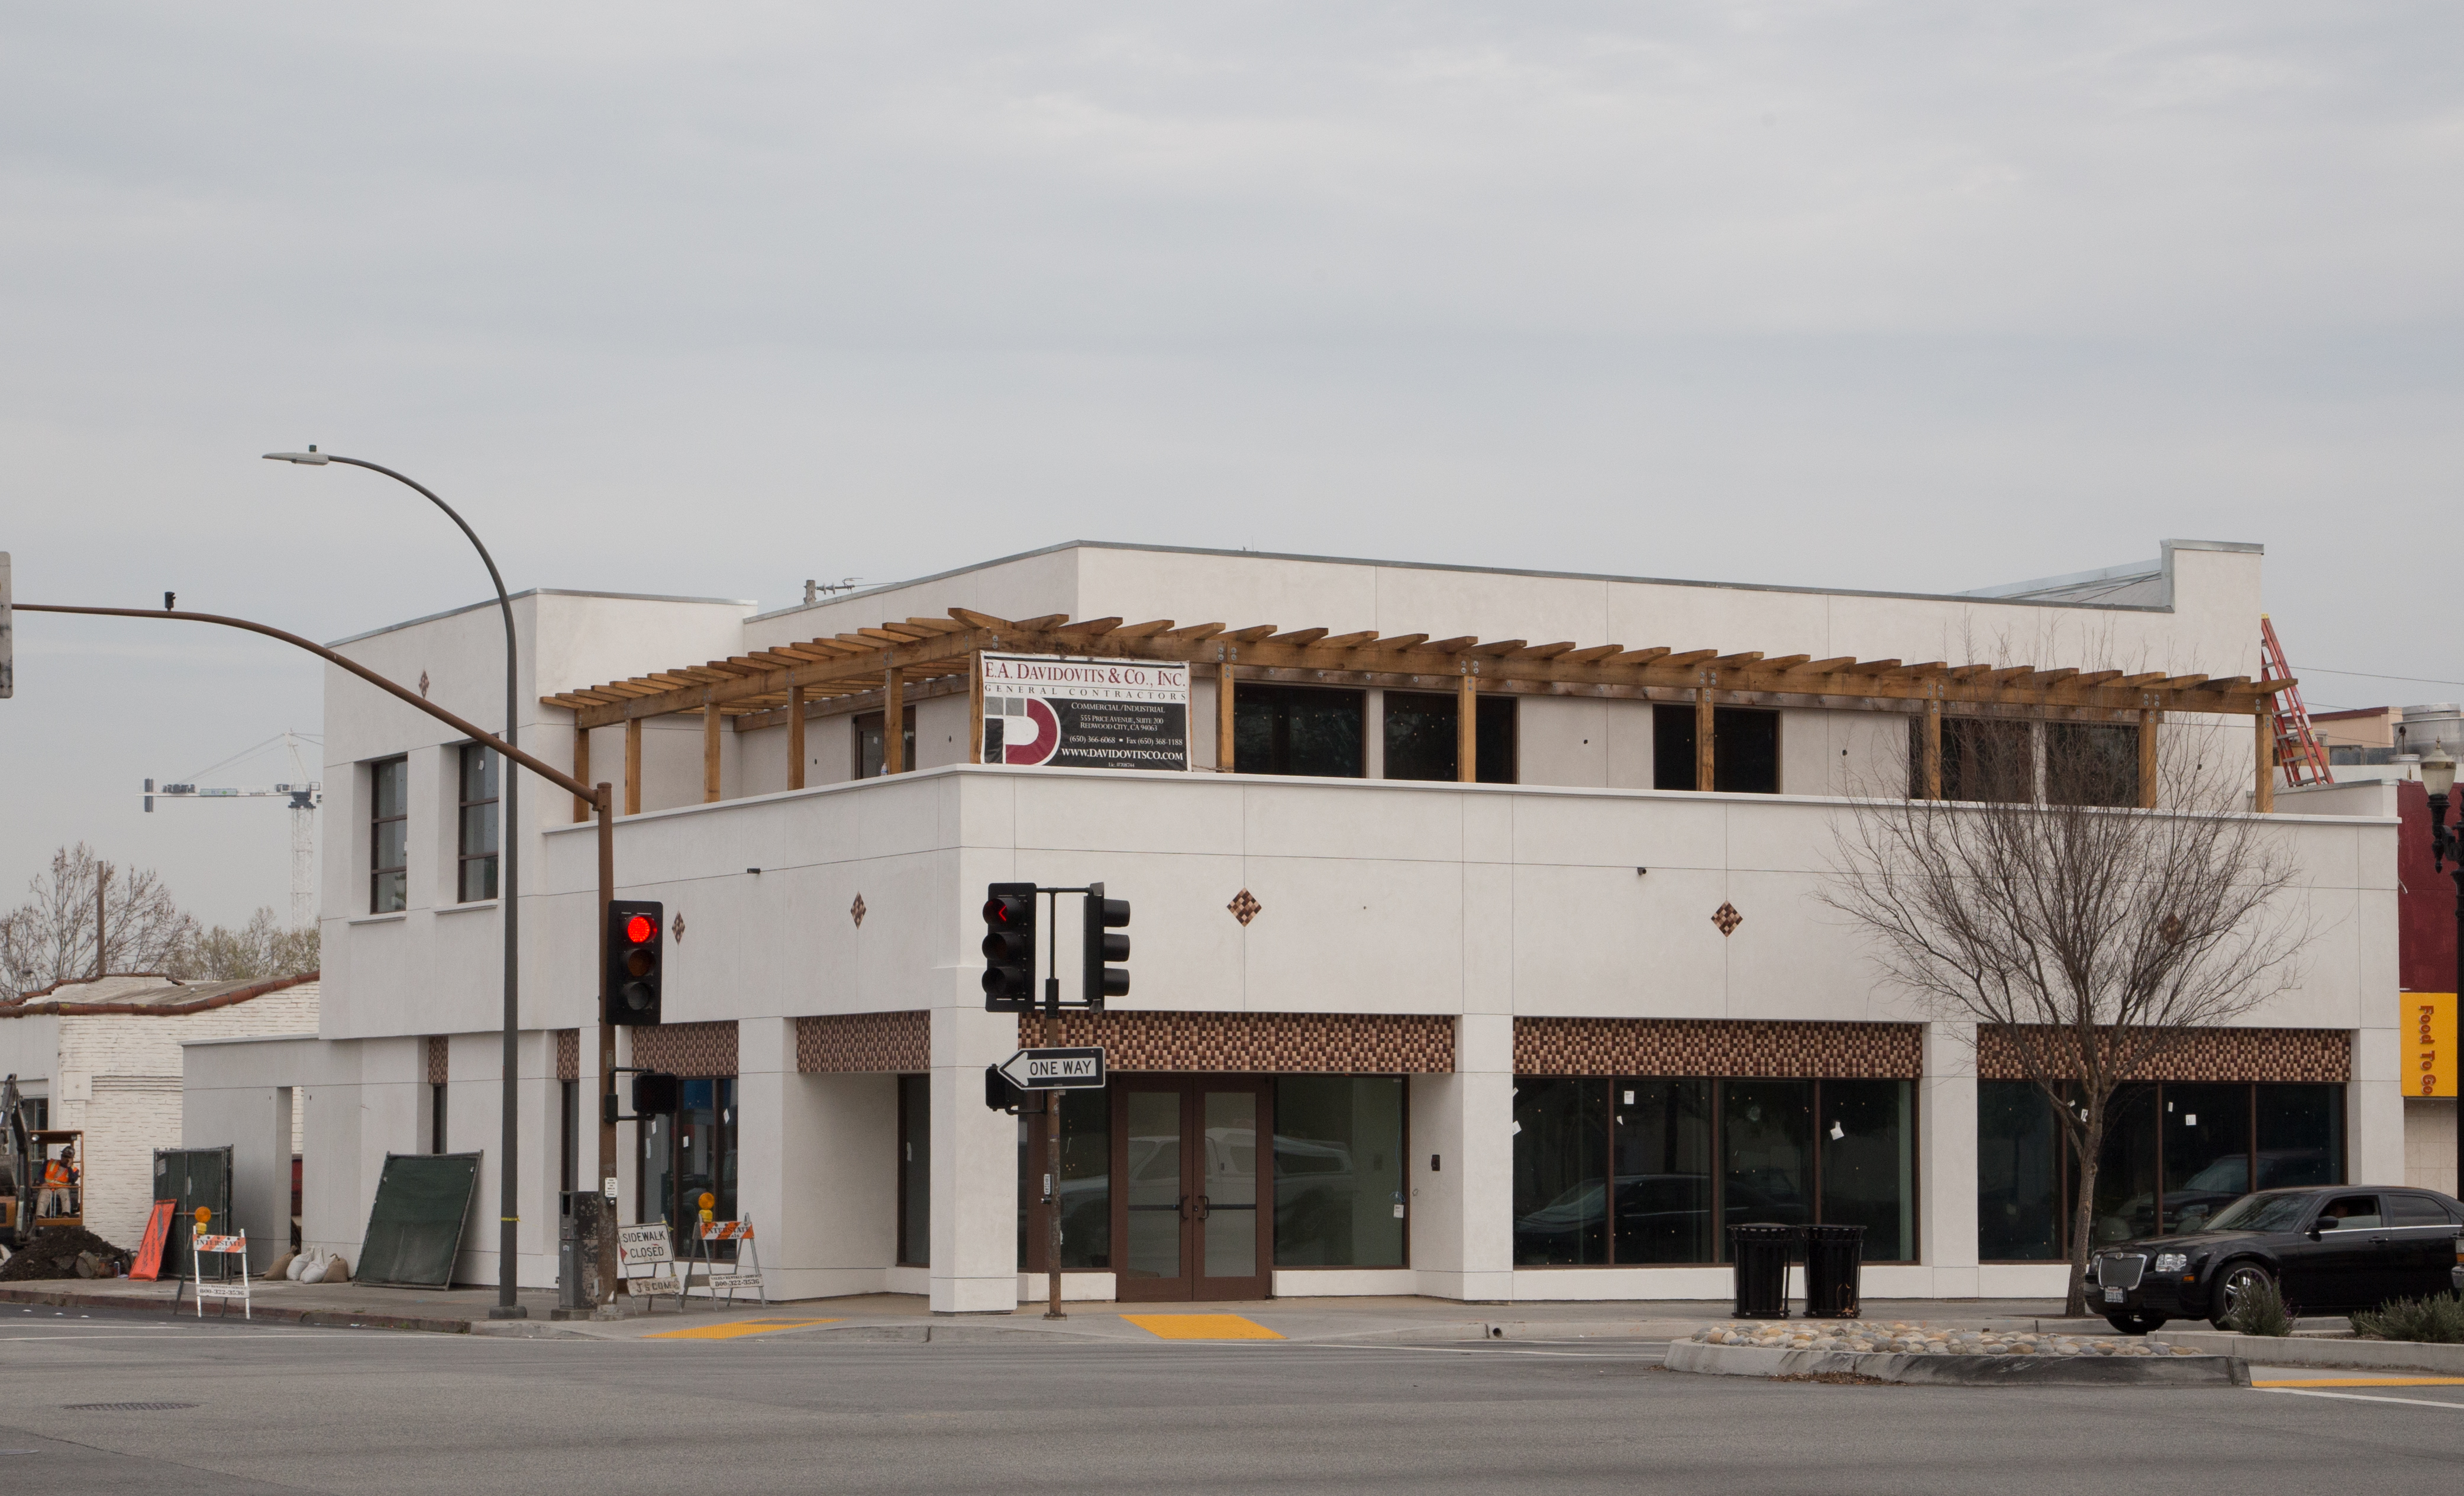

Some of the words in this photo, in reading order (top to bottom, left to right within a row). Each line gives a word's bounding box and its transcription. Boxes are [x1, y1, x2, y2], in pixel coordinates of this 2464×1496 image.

[986, 662, 1013, 679] E.A.
[1017, 663, 1105, 682] DAVIDOVITS
[1108, 668, 1121, 683] &
[1124, 669, 1153, 688] CO.,
[1157, 670, 1186, 686] INC.
[985, 684, 1057, 695] GENERAL
[1069, 688, 1186, 700] CONTRACTORS
[1071, 702, 1165, 713] COMMERCIAL/INDUSTRIAL
[1070, 735, 1086, 743] (650)
[1138, 737, 1154, 746] (650)
[1061, 748, 1183, 760] WWW.DAVIDOVITSCO.COM
[2419, 1005, 2435, 1044] Food
[1030, 1061, 1058, 1075] ONE
[1063, 1060, 1091, 1075] WAY
[2420, 1050, 2436, 1071] To
[2421, 1074, 2437, 1095] Go
[622, 1231, 666, 1243] SIDEWALK
[630, 1247, 664, 1258] CLOSED
